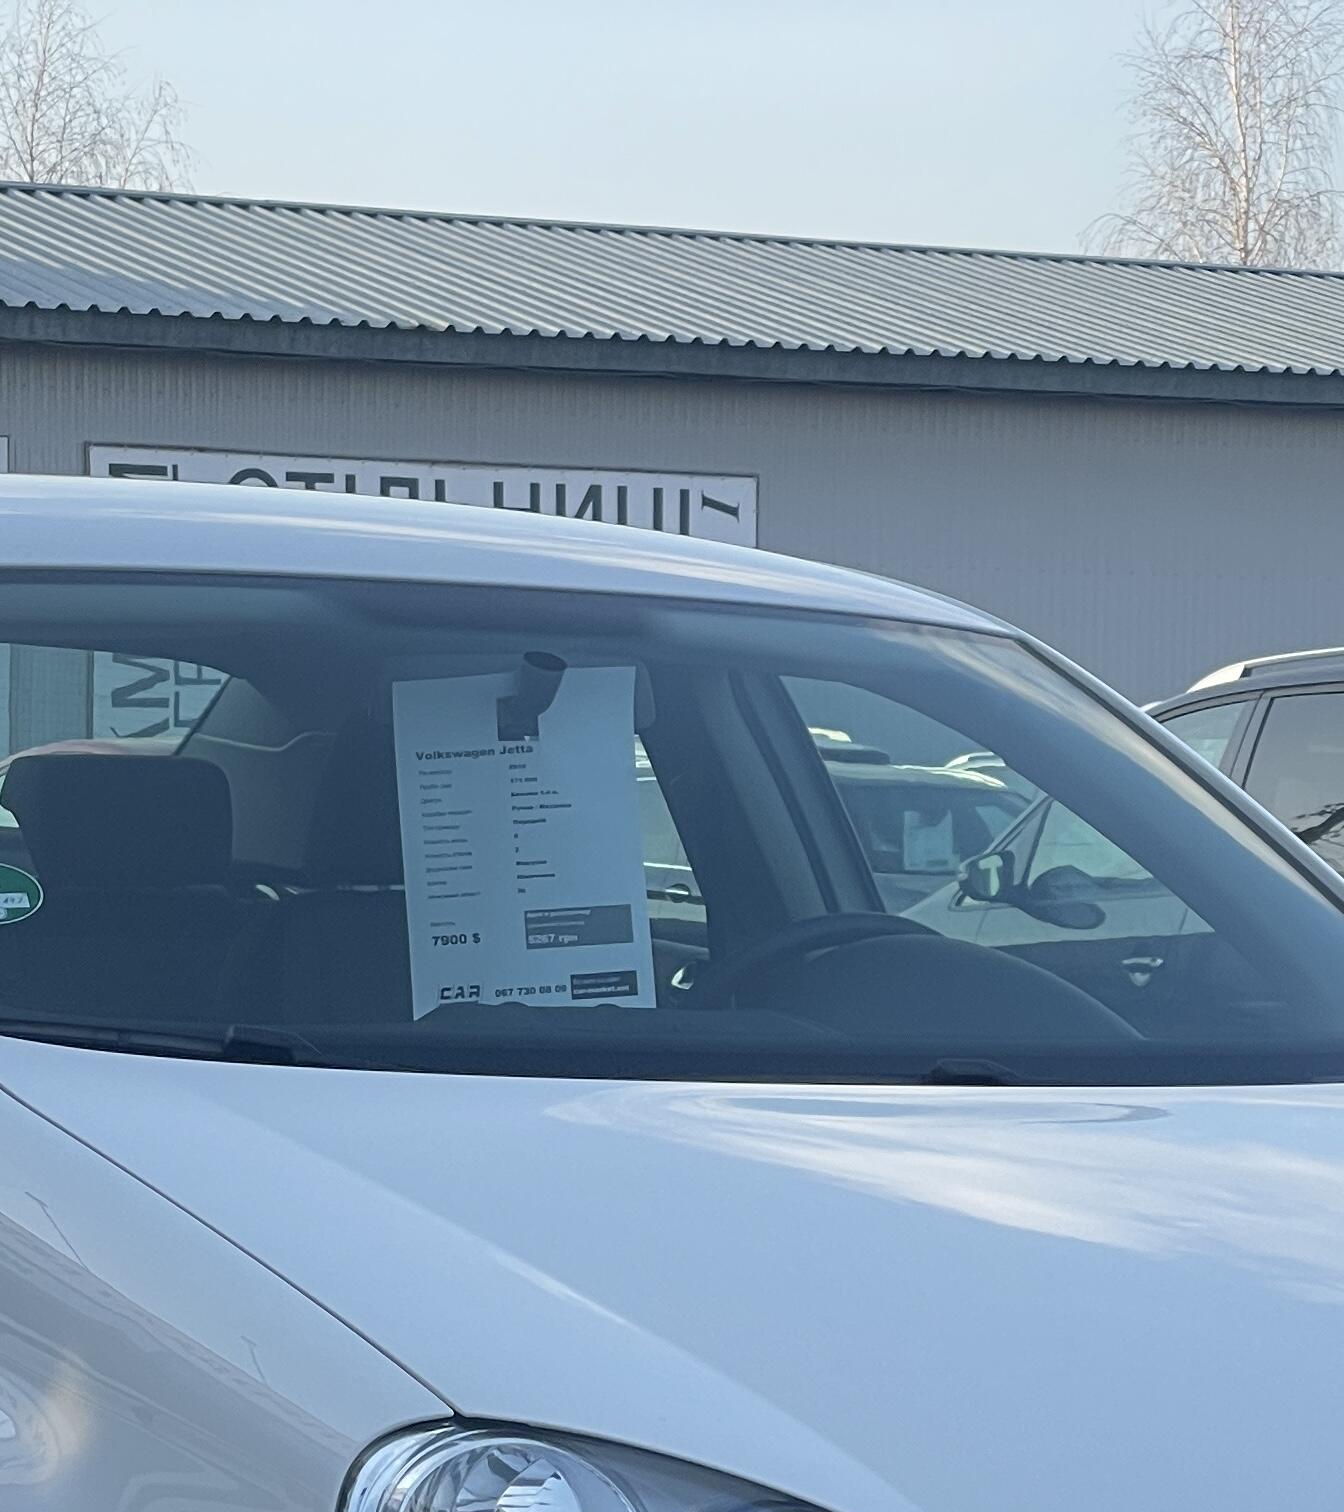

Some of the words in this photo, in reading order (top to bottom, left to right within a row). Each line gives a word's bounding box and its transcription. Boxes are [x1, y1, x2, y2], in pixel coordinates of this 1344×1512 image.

[416, 748, 495, 760] Volkswagen
[500, 745, 534, 755] Jetta
[432, 935, 467, 946] 7900
[472, 932, 481, 944] $
[440, 985, 481, 1000] CAR
